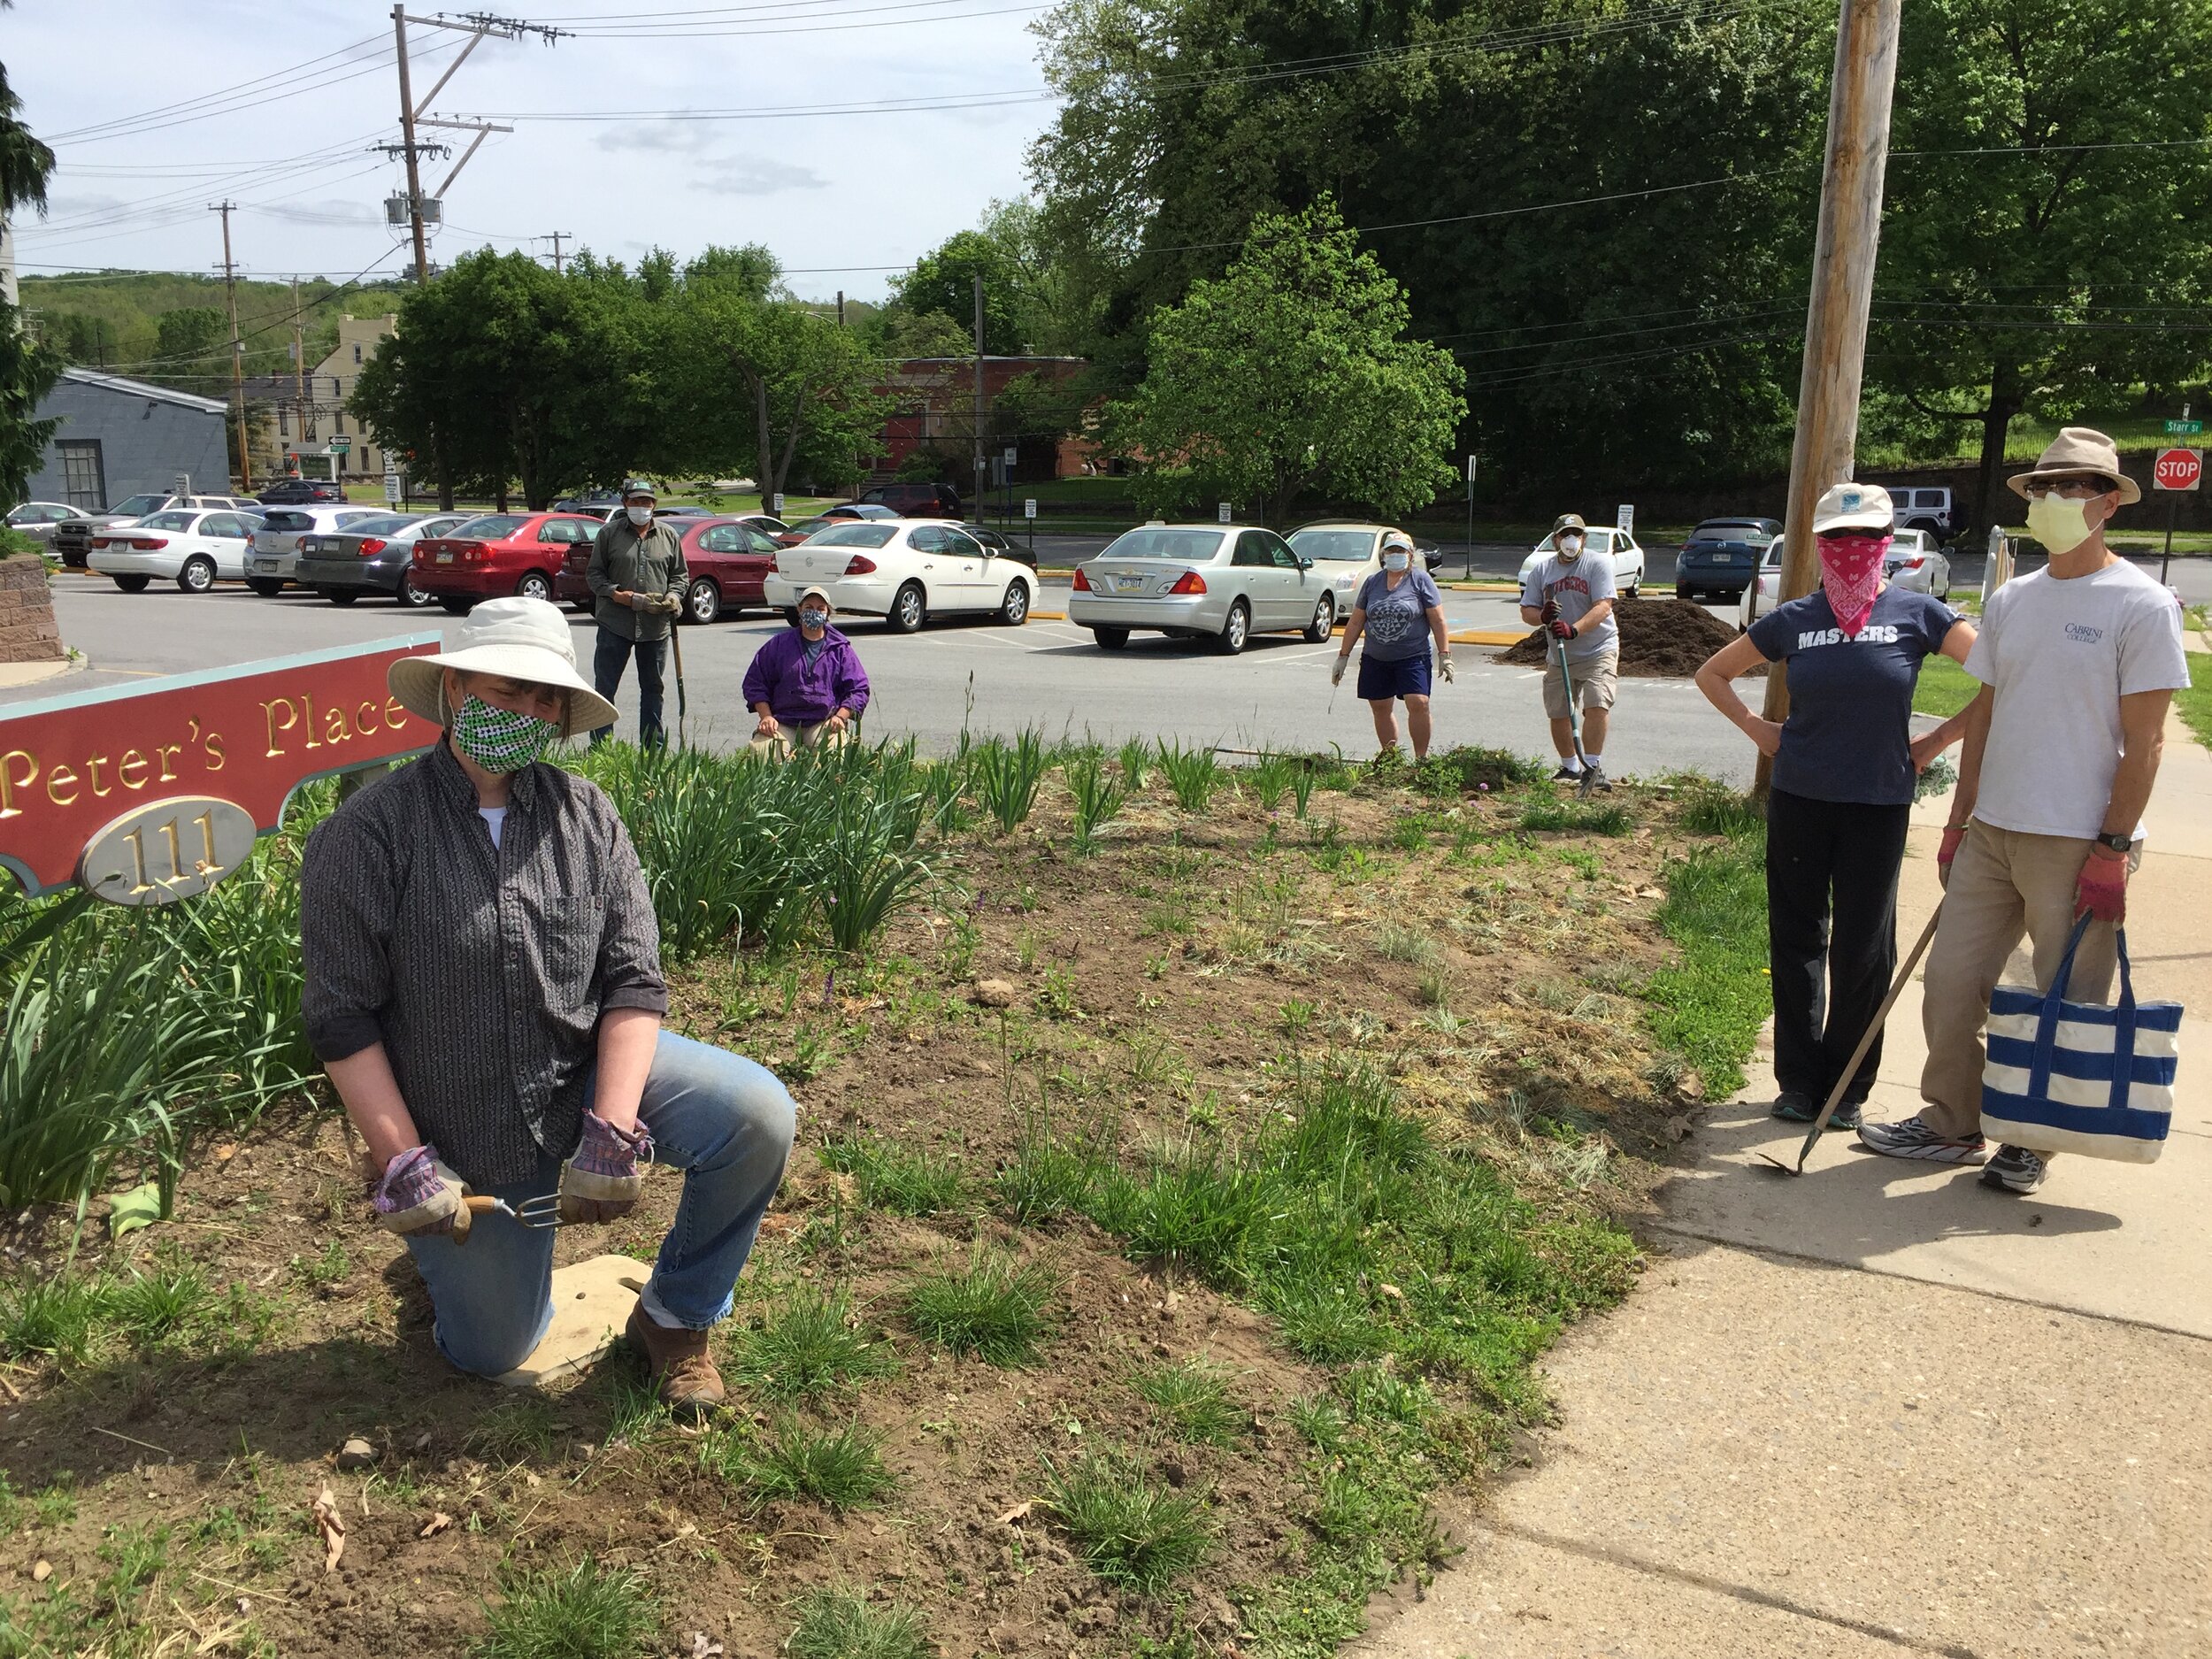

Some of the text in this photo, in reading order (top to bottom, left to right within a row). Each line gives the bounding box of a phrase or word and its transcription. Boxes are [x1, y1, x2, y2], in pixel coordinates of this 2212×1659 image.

[2167, 421, 2189, 432] Starr
[2158, 461, 2199, 477] STOP
[1546, 575, 1589, 595] TGERS
[1798, 626, 1898, 649] MASTERS
[2065, 622, 2103, 639] CABRINI
[0, 691, 408, 818] Peter's Place
[123, 809, 225, 895] 111
